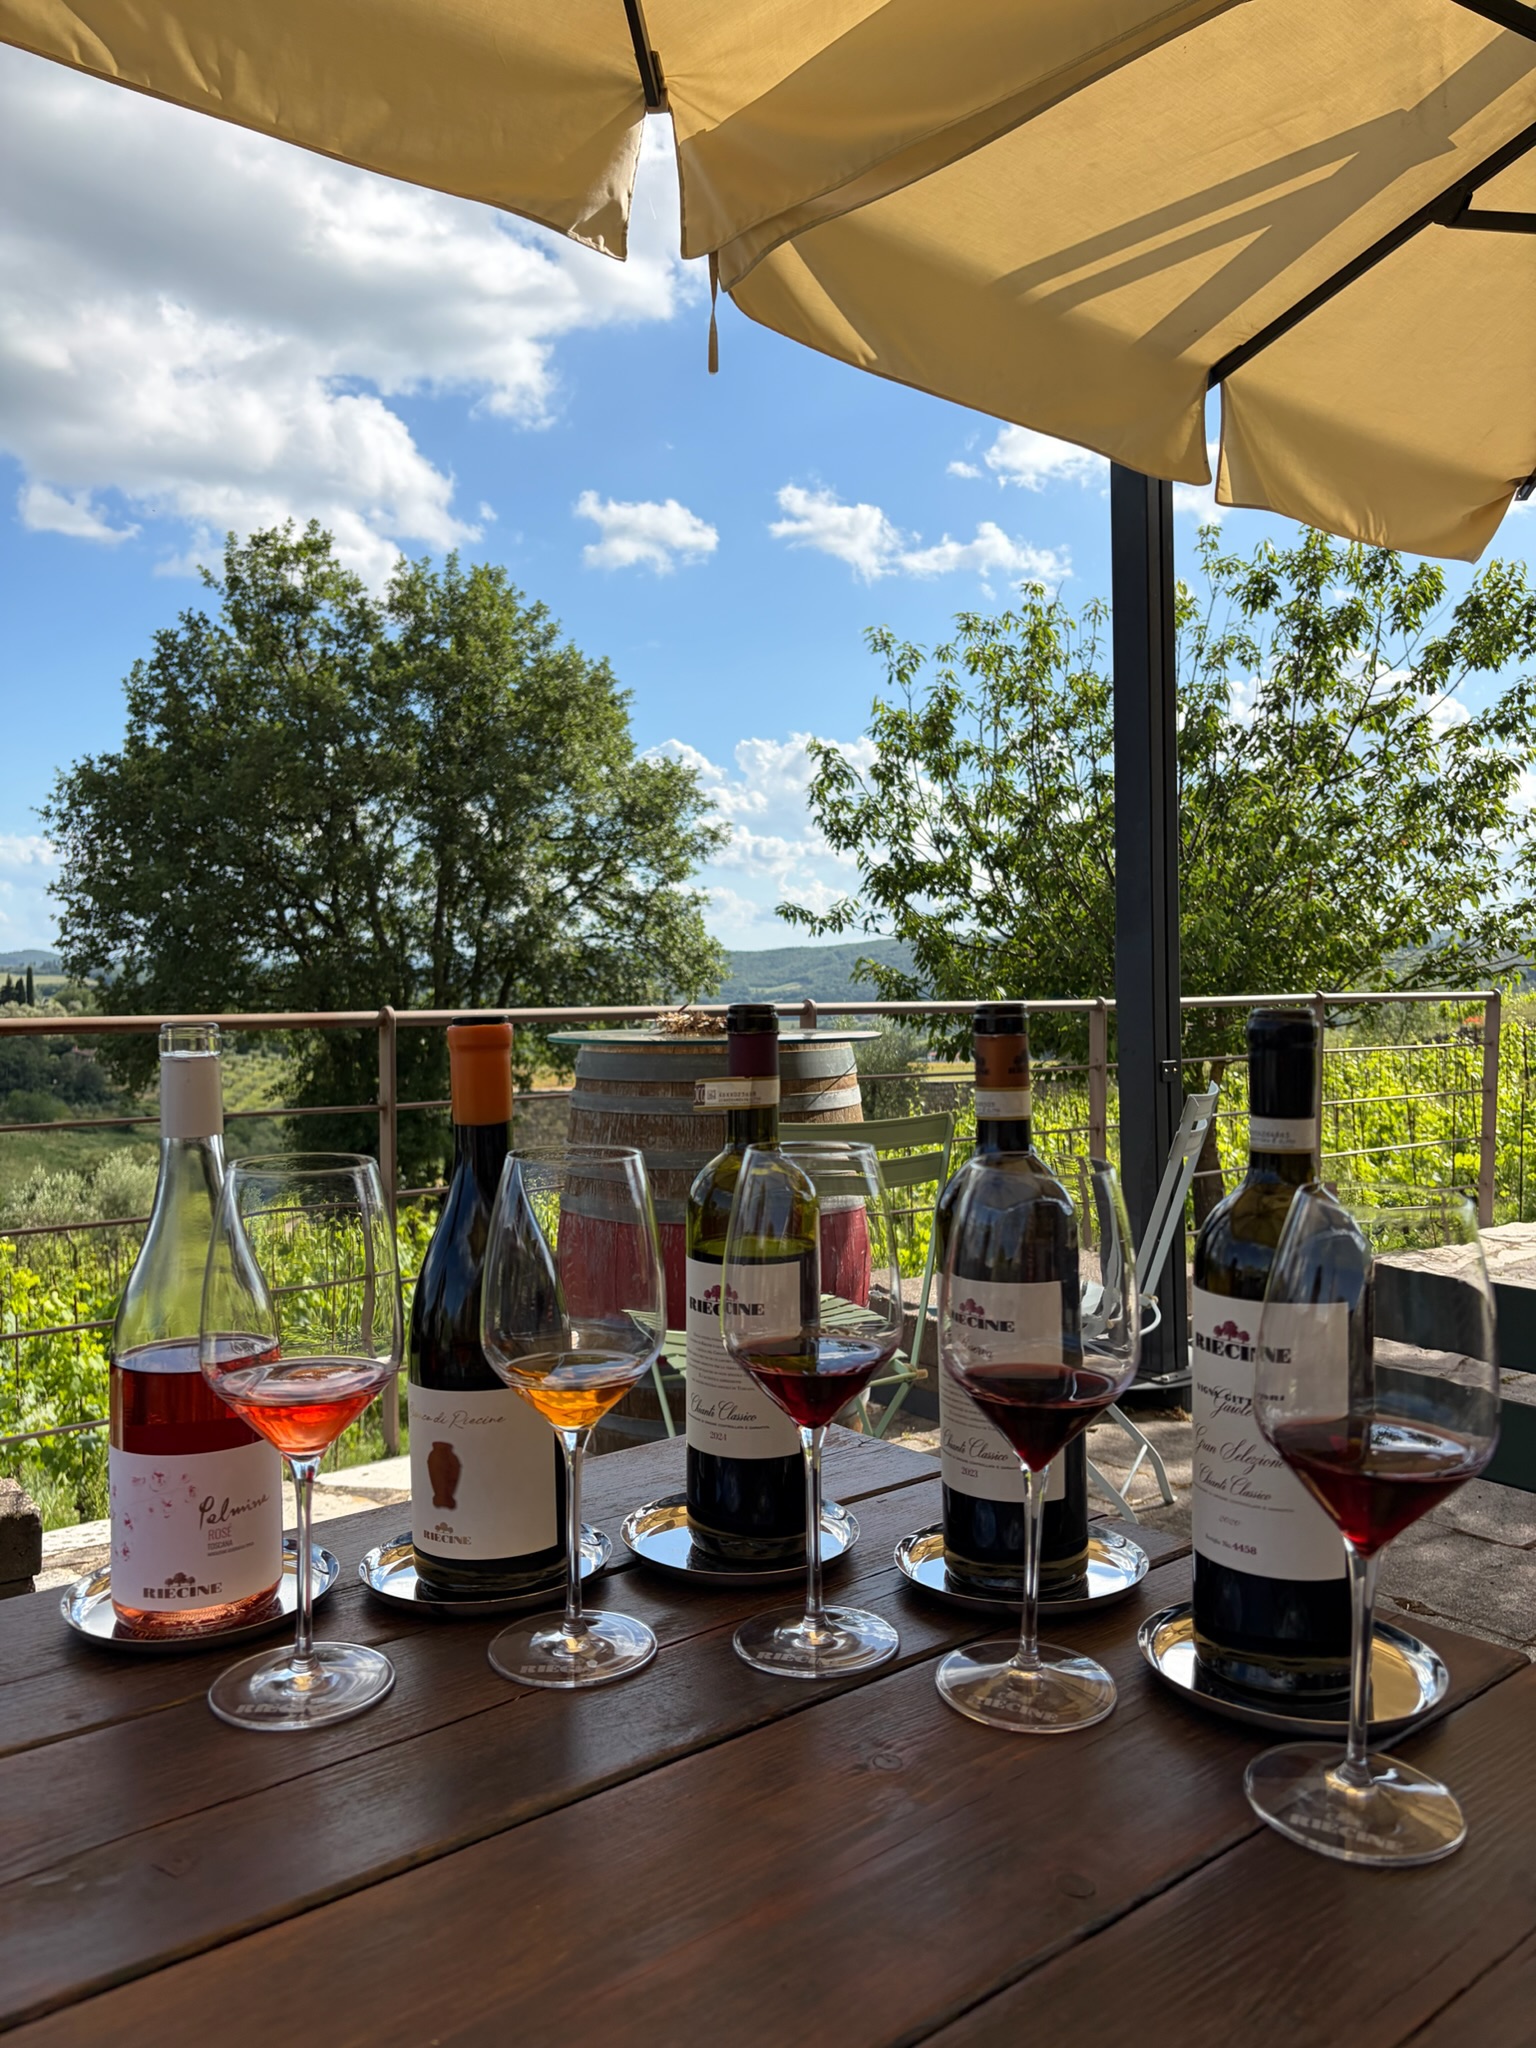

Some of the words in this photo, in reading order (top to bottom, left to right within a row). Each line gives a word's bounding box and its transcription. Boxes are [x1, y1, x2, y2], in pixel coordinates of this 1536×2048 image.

[689, 1296, 765, 1317] RIECINE
[1195, 1331, 1292, 1364] RIECINE
[691, 1392, 715, 1418] Chianti
[718, 1400, 757, 1422] Classico
[943, 1428, 966, 1454] Chianti
[968, 1437, 1009, 1461] Classico
[1194, 1422, 1217, 1455] Gran
[1220, 1438, 1285, 1475] Selezione
[1199, 1462, 1227, 1491] Chianti
[1230, 1475, 1272, 1500] Classico
[423, 1529, 472, 1545] RIECINE
[1232, 1542, 1257, 1555] 4458
[143, 1582, 223, 1599] RIECINE
